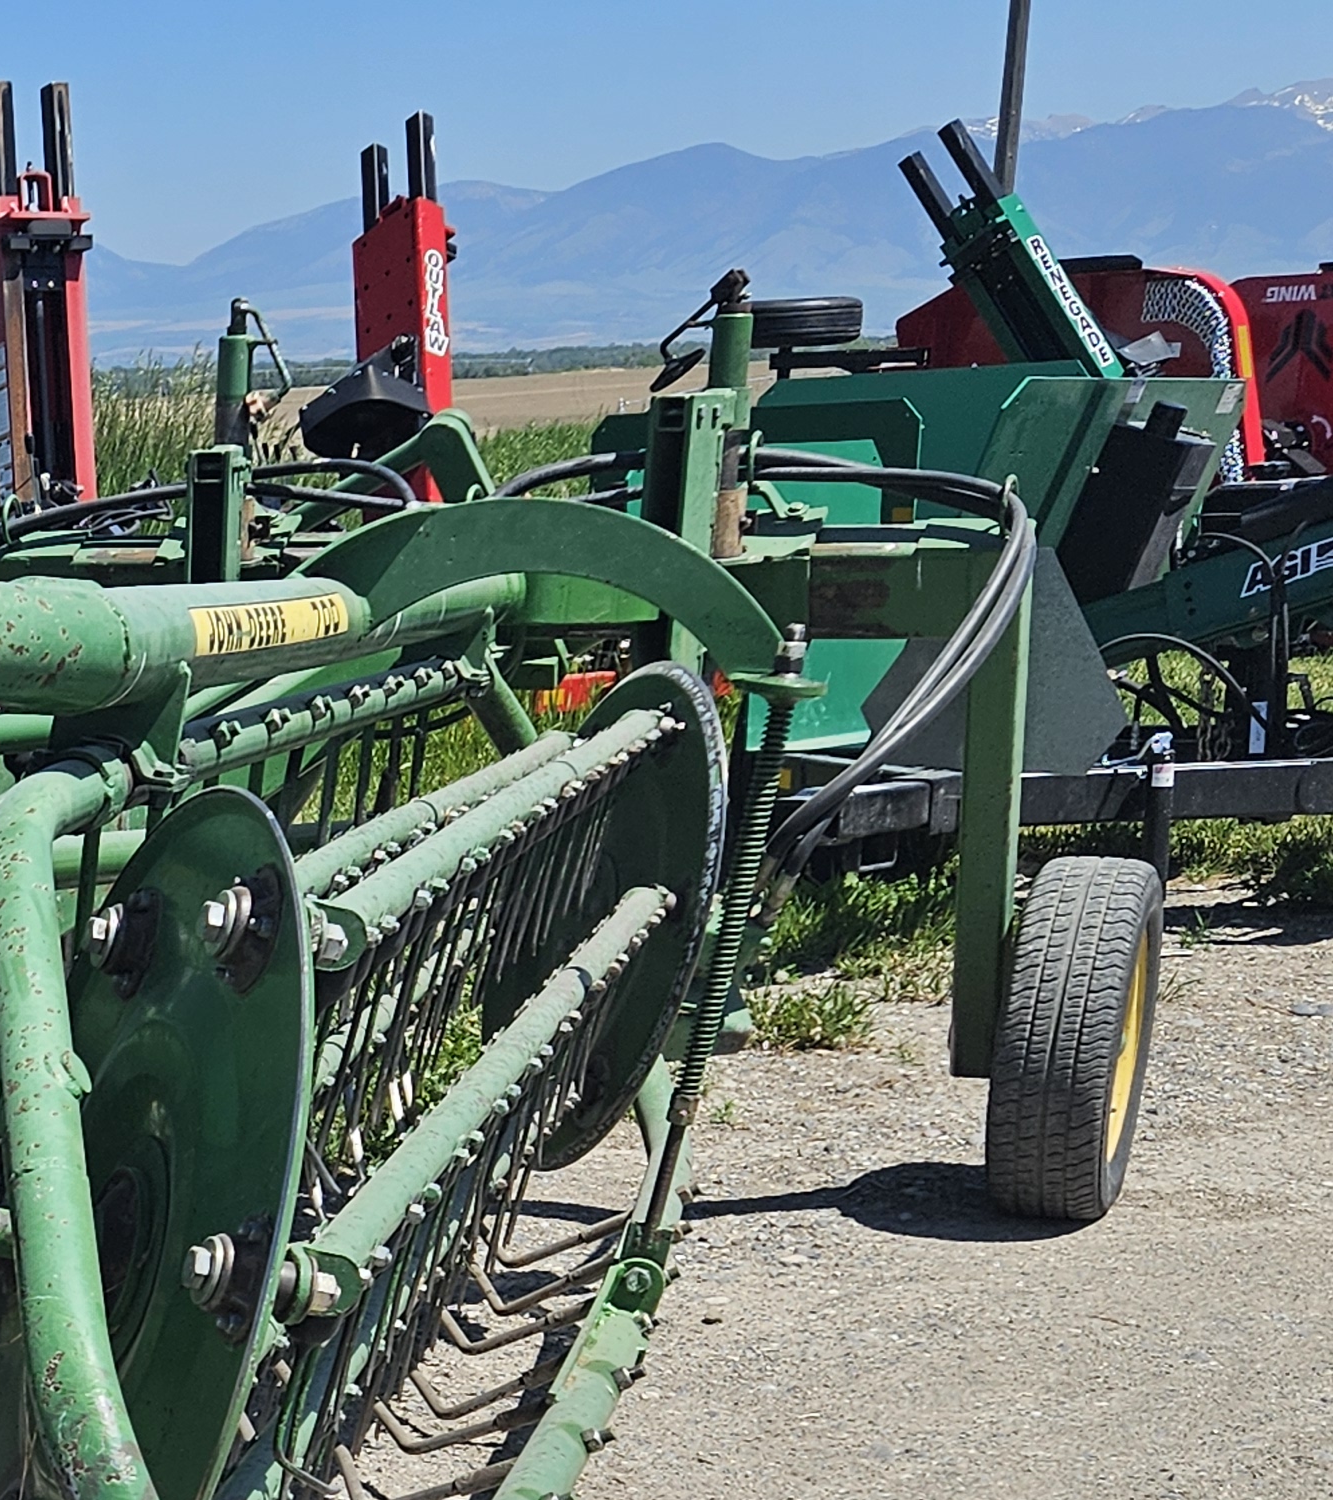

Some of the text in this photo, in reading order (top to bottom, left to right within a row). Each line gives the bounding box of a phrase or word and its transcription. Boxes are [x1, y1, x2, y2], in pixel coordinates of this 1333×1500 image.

[426, 250, 447, 354] OUTLAW
[1028, 236, 1112, 365] RENEGADE
[207, 598, 341, 653] JOHN DEERE 700
